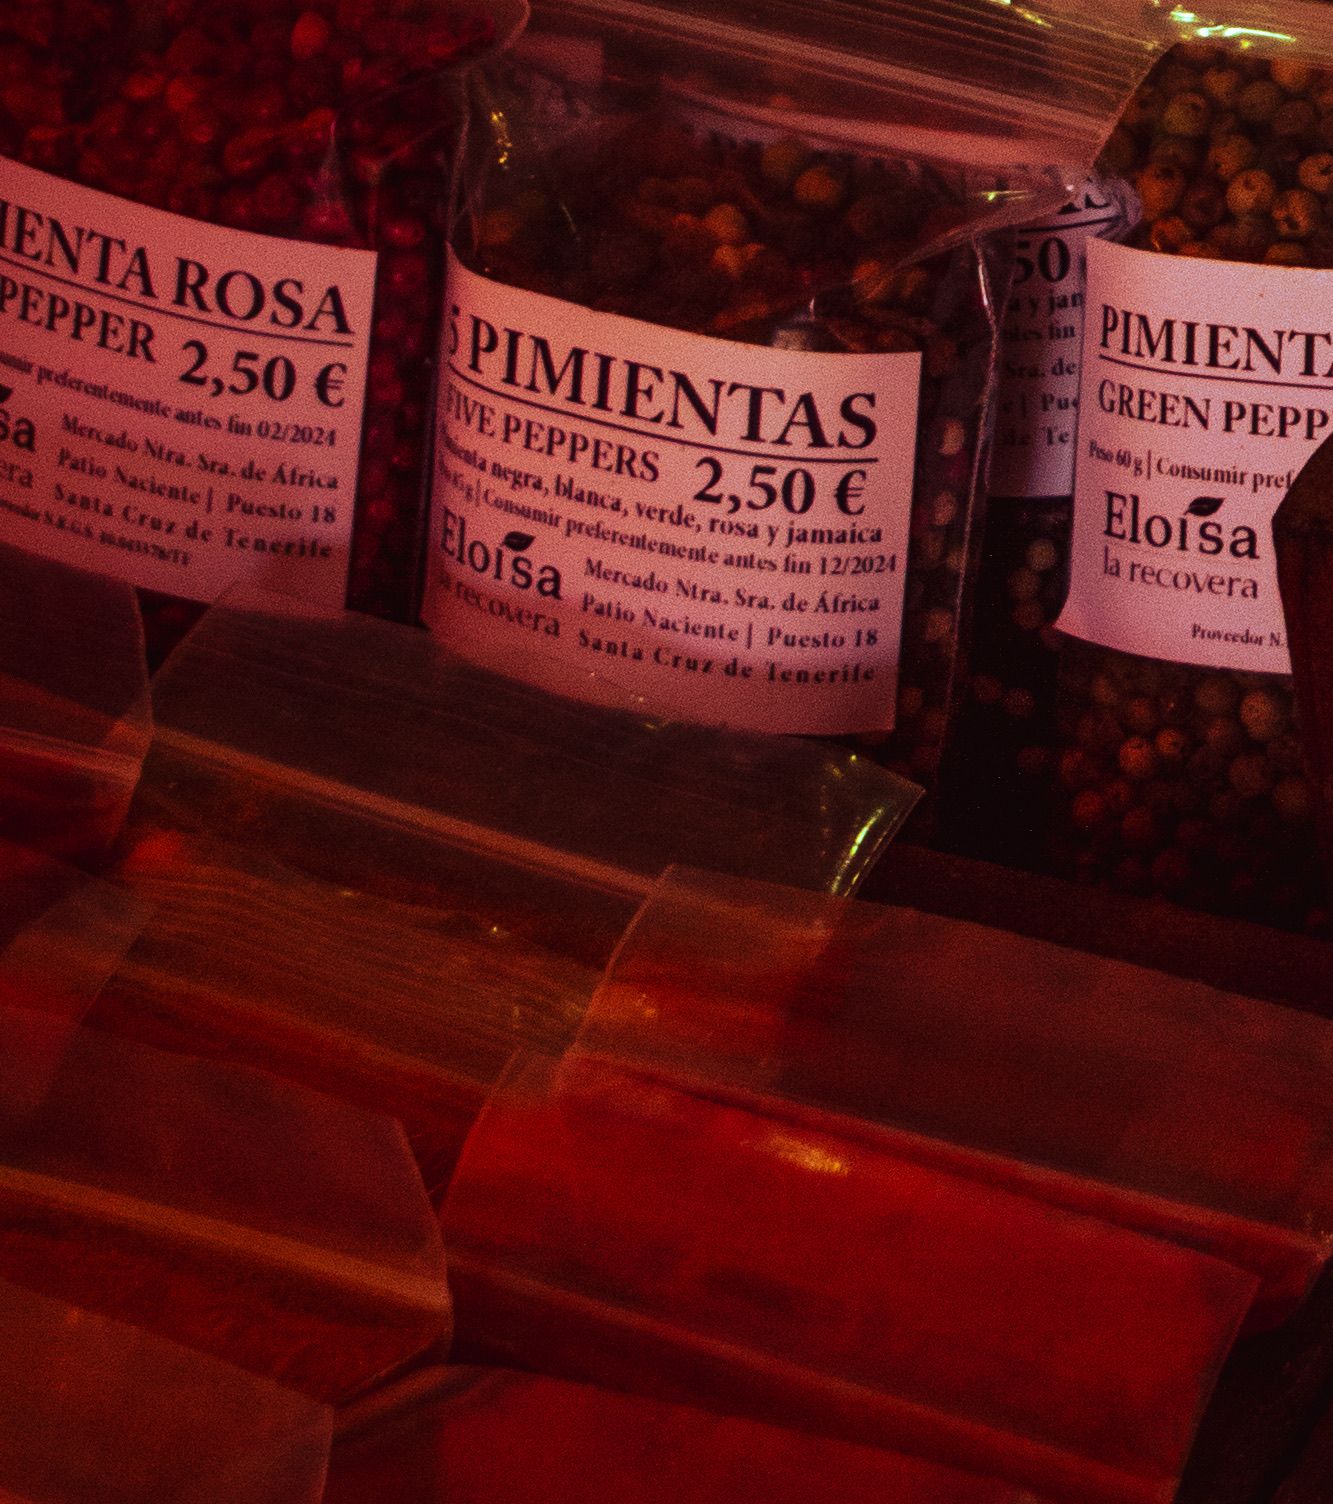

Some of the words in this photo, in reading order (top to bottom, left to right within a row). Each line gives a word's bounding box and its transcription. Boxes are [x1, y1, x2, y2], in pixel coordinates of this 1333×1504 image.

[172, 255, 356, 336] ROSA
[179, 338, 297, 403] 2,50
[315, 360, 349, 409] €
[468, 314, 877, 451] PIMIENTAS
[1098, 378, 1211, 432] GREEN
[502, 413, 662, 485] PEPPERS
[692, 454, 815, 516] 2,50
[835, 468, 868, 518] €
[555, 474, 630, 518] blanca,
[634, 500, 703, 535] verde,
[708, 514, 760, 540] rosa
[767, 524, 780, 548] y
[784, 520, 882, 548] jamaica
[565, 516, 719, 566] preferentemente
[722, 548, 777, 573] antes
[1104, 489, 1261, 560] Eloísa
[1103, 544, 1121, 579] la
[1129, 560, 1259, 600] recovera
